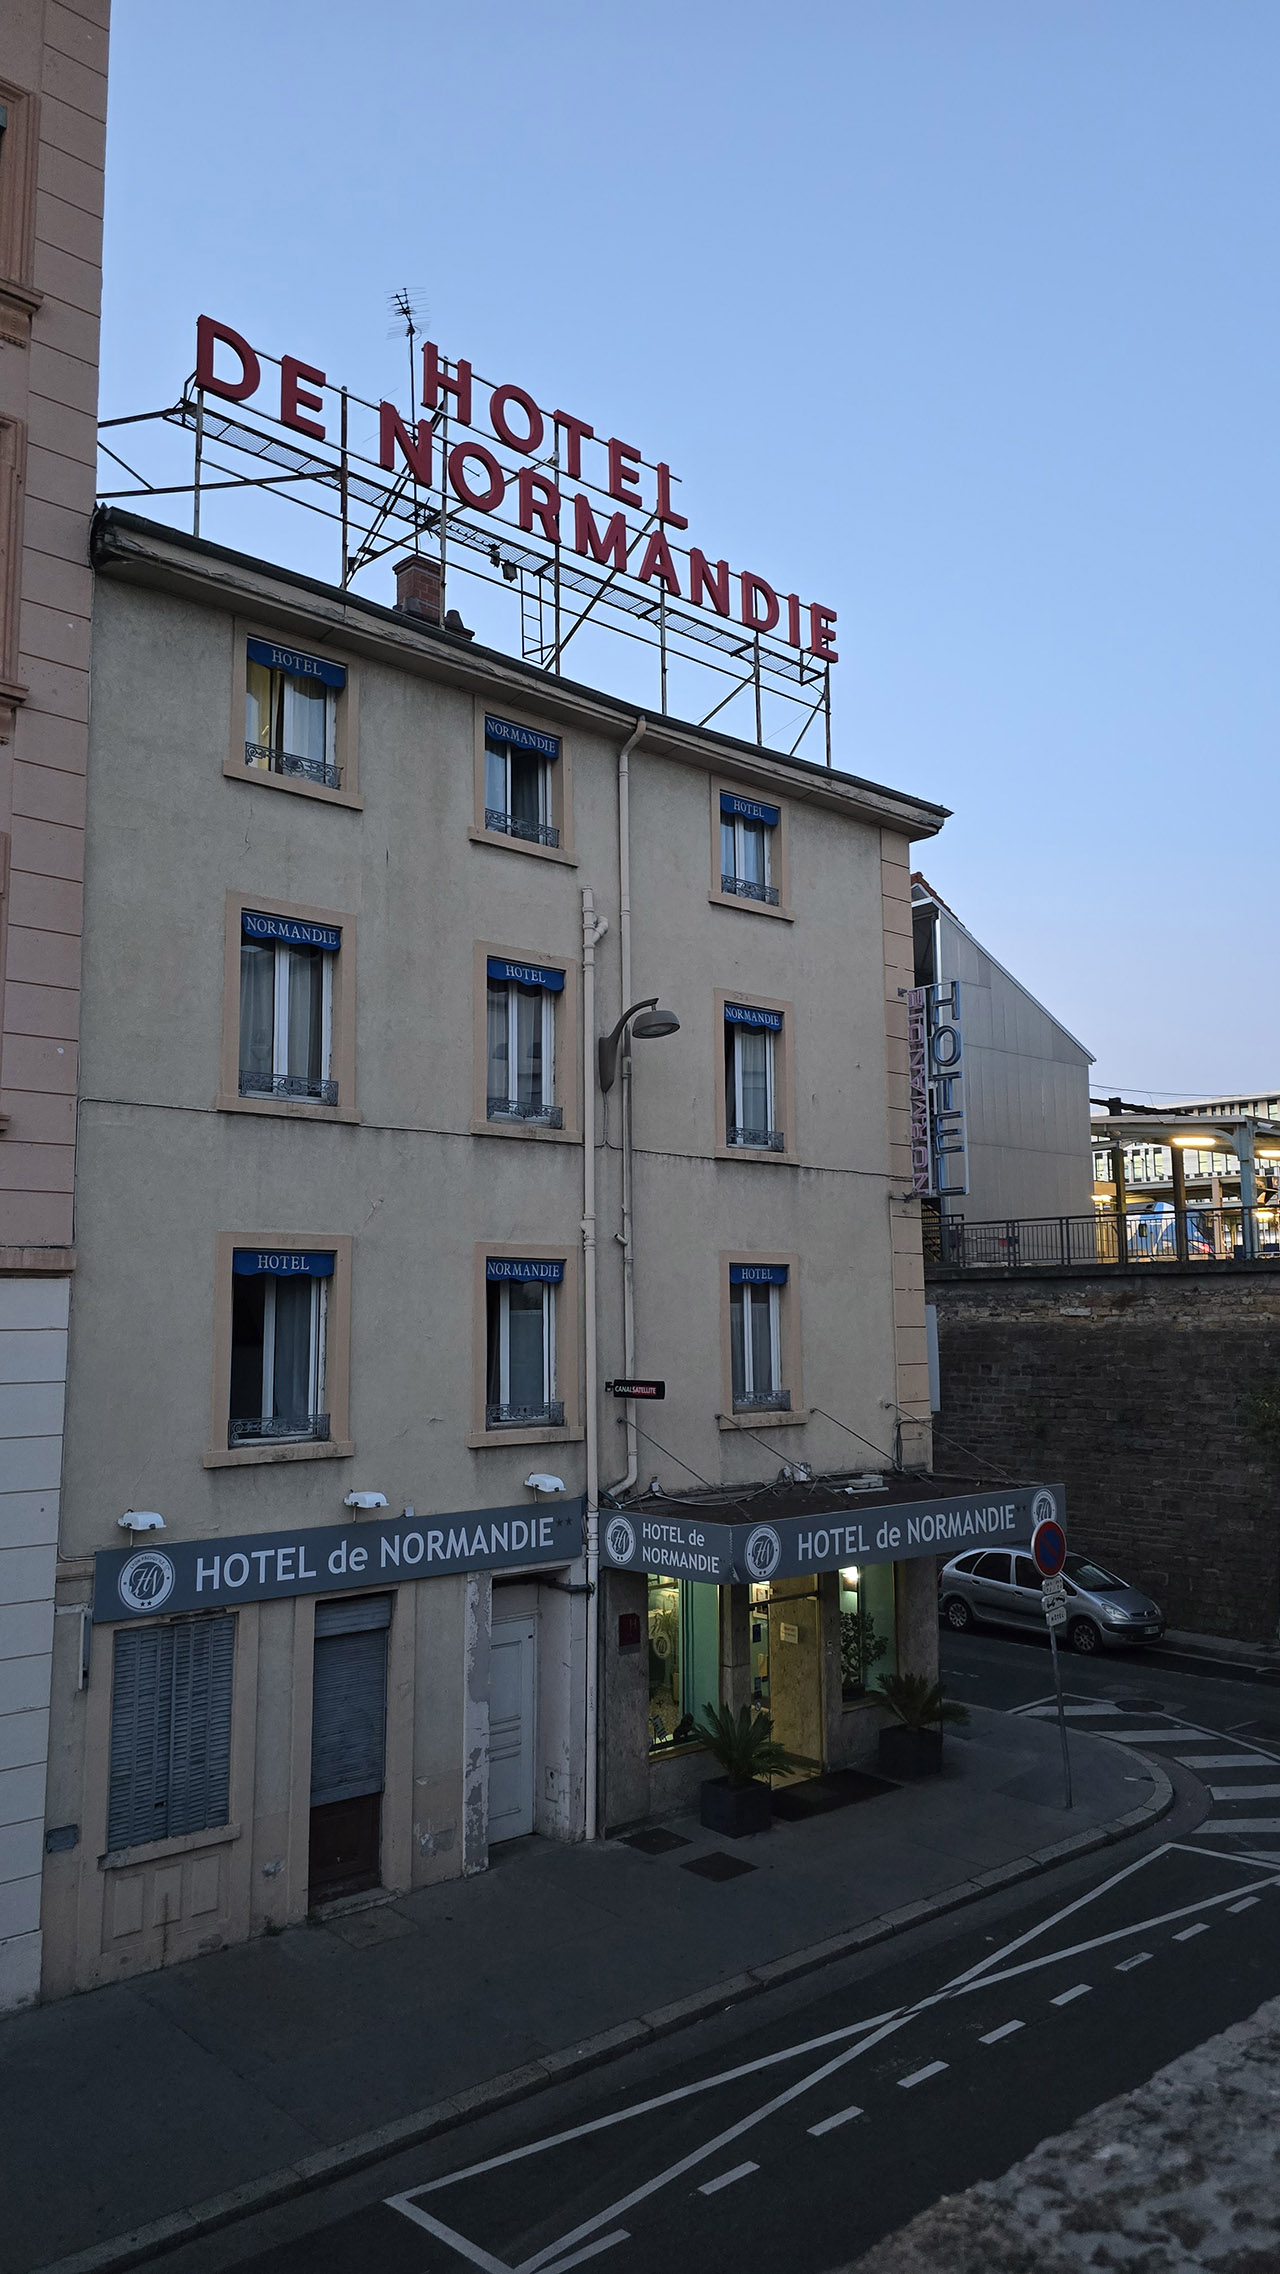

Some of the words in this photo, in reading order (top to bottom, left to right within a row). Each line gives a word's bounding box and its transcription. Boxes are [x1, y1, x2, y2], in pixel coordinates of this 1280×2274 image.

[421, 341, 688, 531] HOTEL
[196, 314, 326, 440] DE
[379, 400, 839, 664] NORMANDIE
[271, 648, 323, 677] HOTEL
[486, 719, 559, 755] NORMANDIE
[733, 799, 765, 819] HOTEL
[245, 916, 337, 947] NORMANDIE
[504, 965, 546, 985] HOTEL
[724, 1005, 780, 1027] NORMANDIE
[908, 988, 929, 1195] NORMANDIE
[930, 980, 967, 1196] HOTEL
[257, 1254, 310, 1271] HOTEL
[486, 1260, 561, 1279] NORMANDIE
[740, 1267, 774, 1281] HOTEL
[642, 1522, 685, 1544] HOTEL
[688, 1529, 705, 1547] de
[798, 1527, 871, 1562] HOTEL
[876, 1522, 900, 1549] de
[907, 1503, 1016, 1545] NORMANDIE
[196, 1546, 316, 1592] HOTEL
[328, 1540, 369, 1575] de
[380, 1516, 554, 1568] NORMANDIE
[642, 1546, 720, 1574] NORMANDIE
